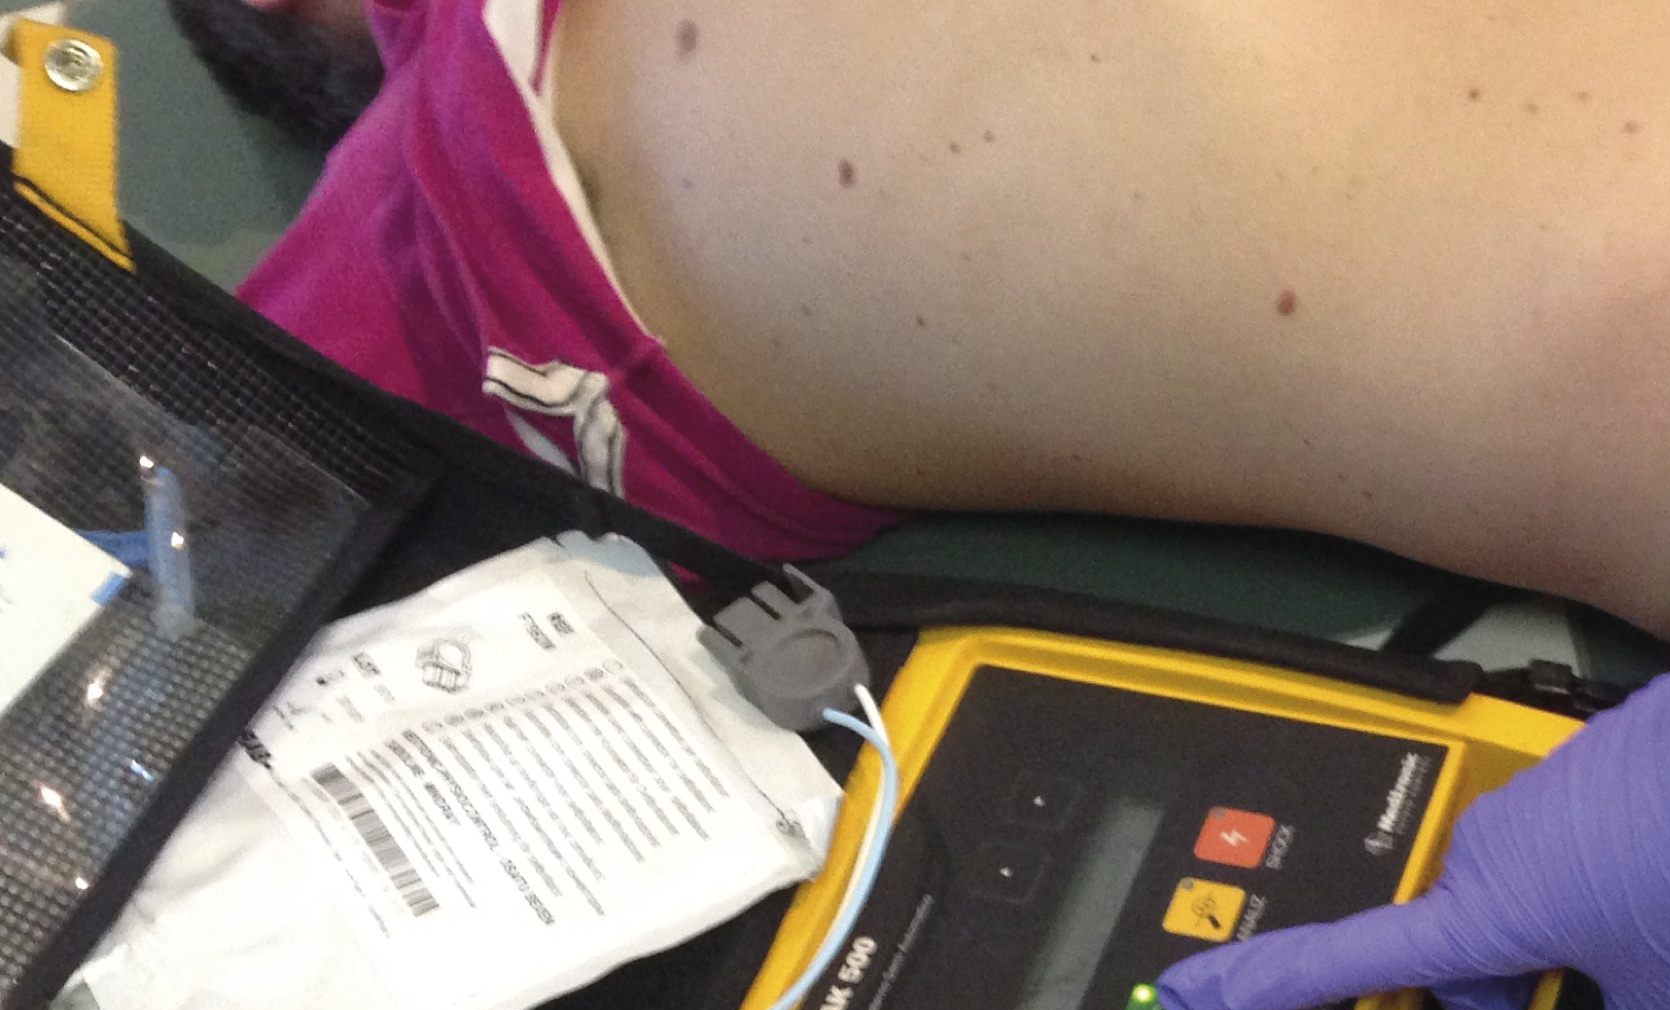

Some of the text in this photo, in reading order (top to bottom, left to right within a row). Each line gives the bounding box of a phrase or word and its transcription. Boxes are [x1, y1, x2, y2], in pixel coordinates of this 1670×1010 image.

[1374, 749, 1422, 832] Medtronic
[1263, 821, 1298, 871] SHOCK
[835, 931, 880, 987] 500
